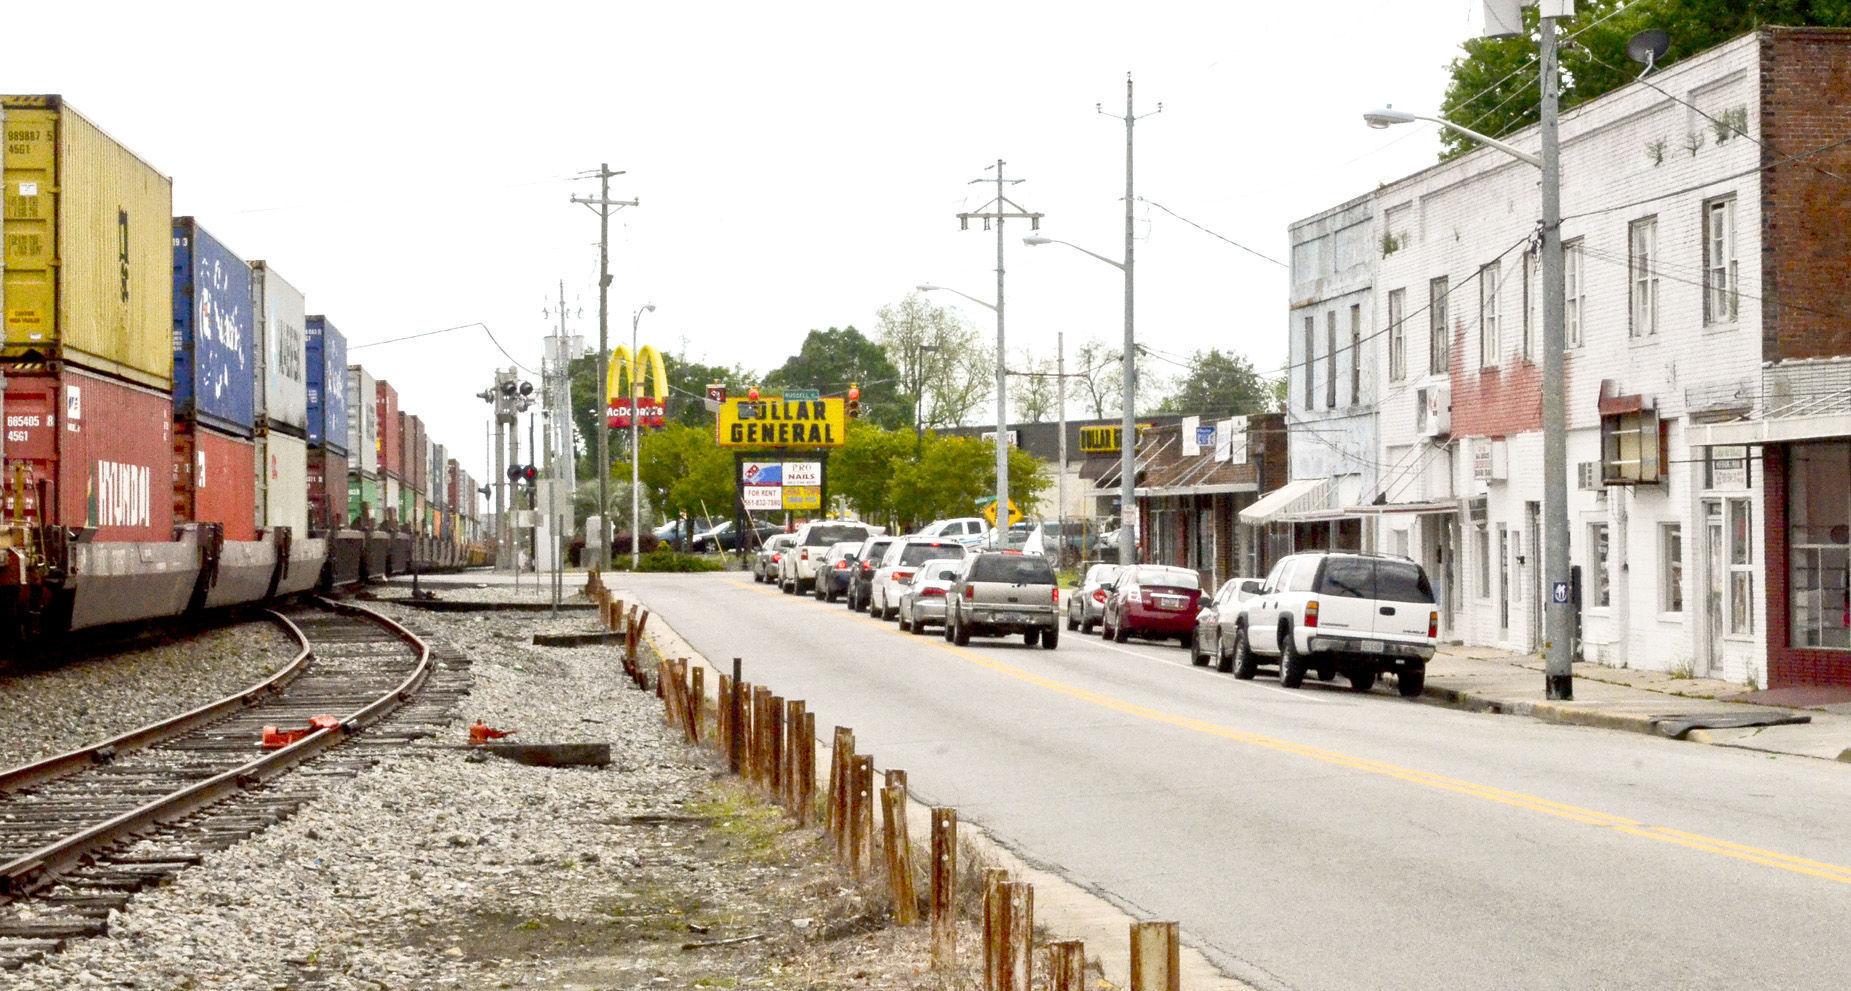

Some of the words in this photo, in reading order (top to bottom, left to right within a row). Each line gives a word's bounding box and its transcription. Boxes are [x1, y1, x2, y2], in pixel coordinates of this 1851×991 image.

[47, 131, 53, 141] 5
[46, 415, 54, 427] 8
[731, 423, 835, 443] GENERAL
[98, 460, 150, 527] HYUNDAI
[748, 489, 760, 497] FOR
[761, 489, 776, 497] RENT
